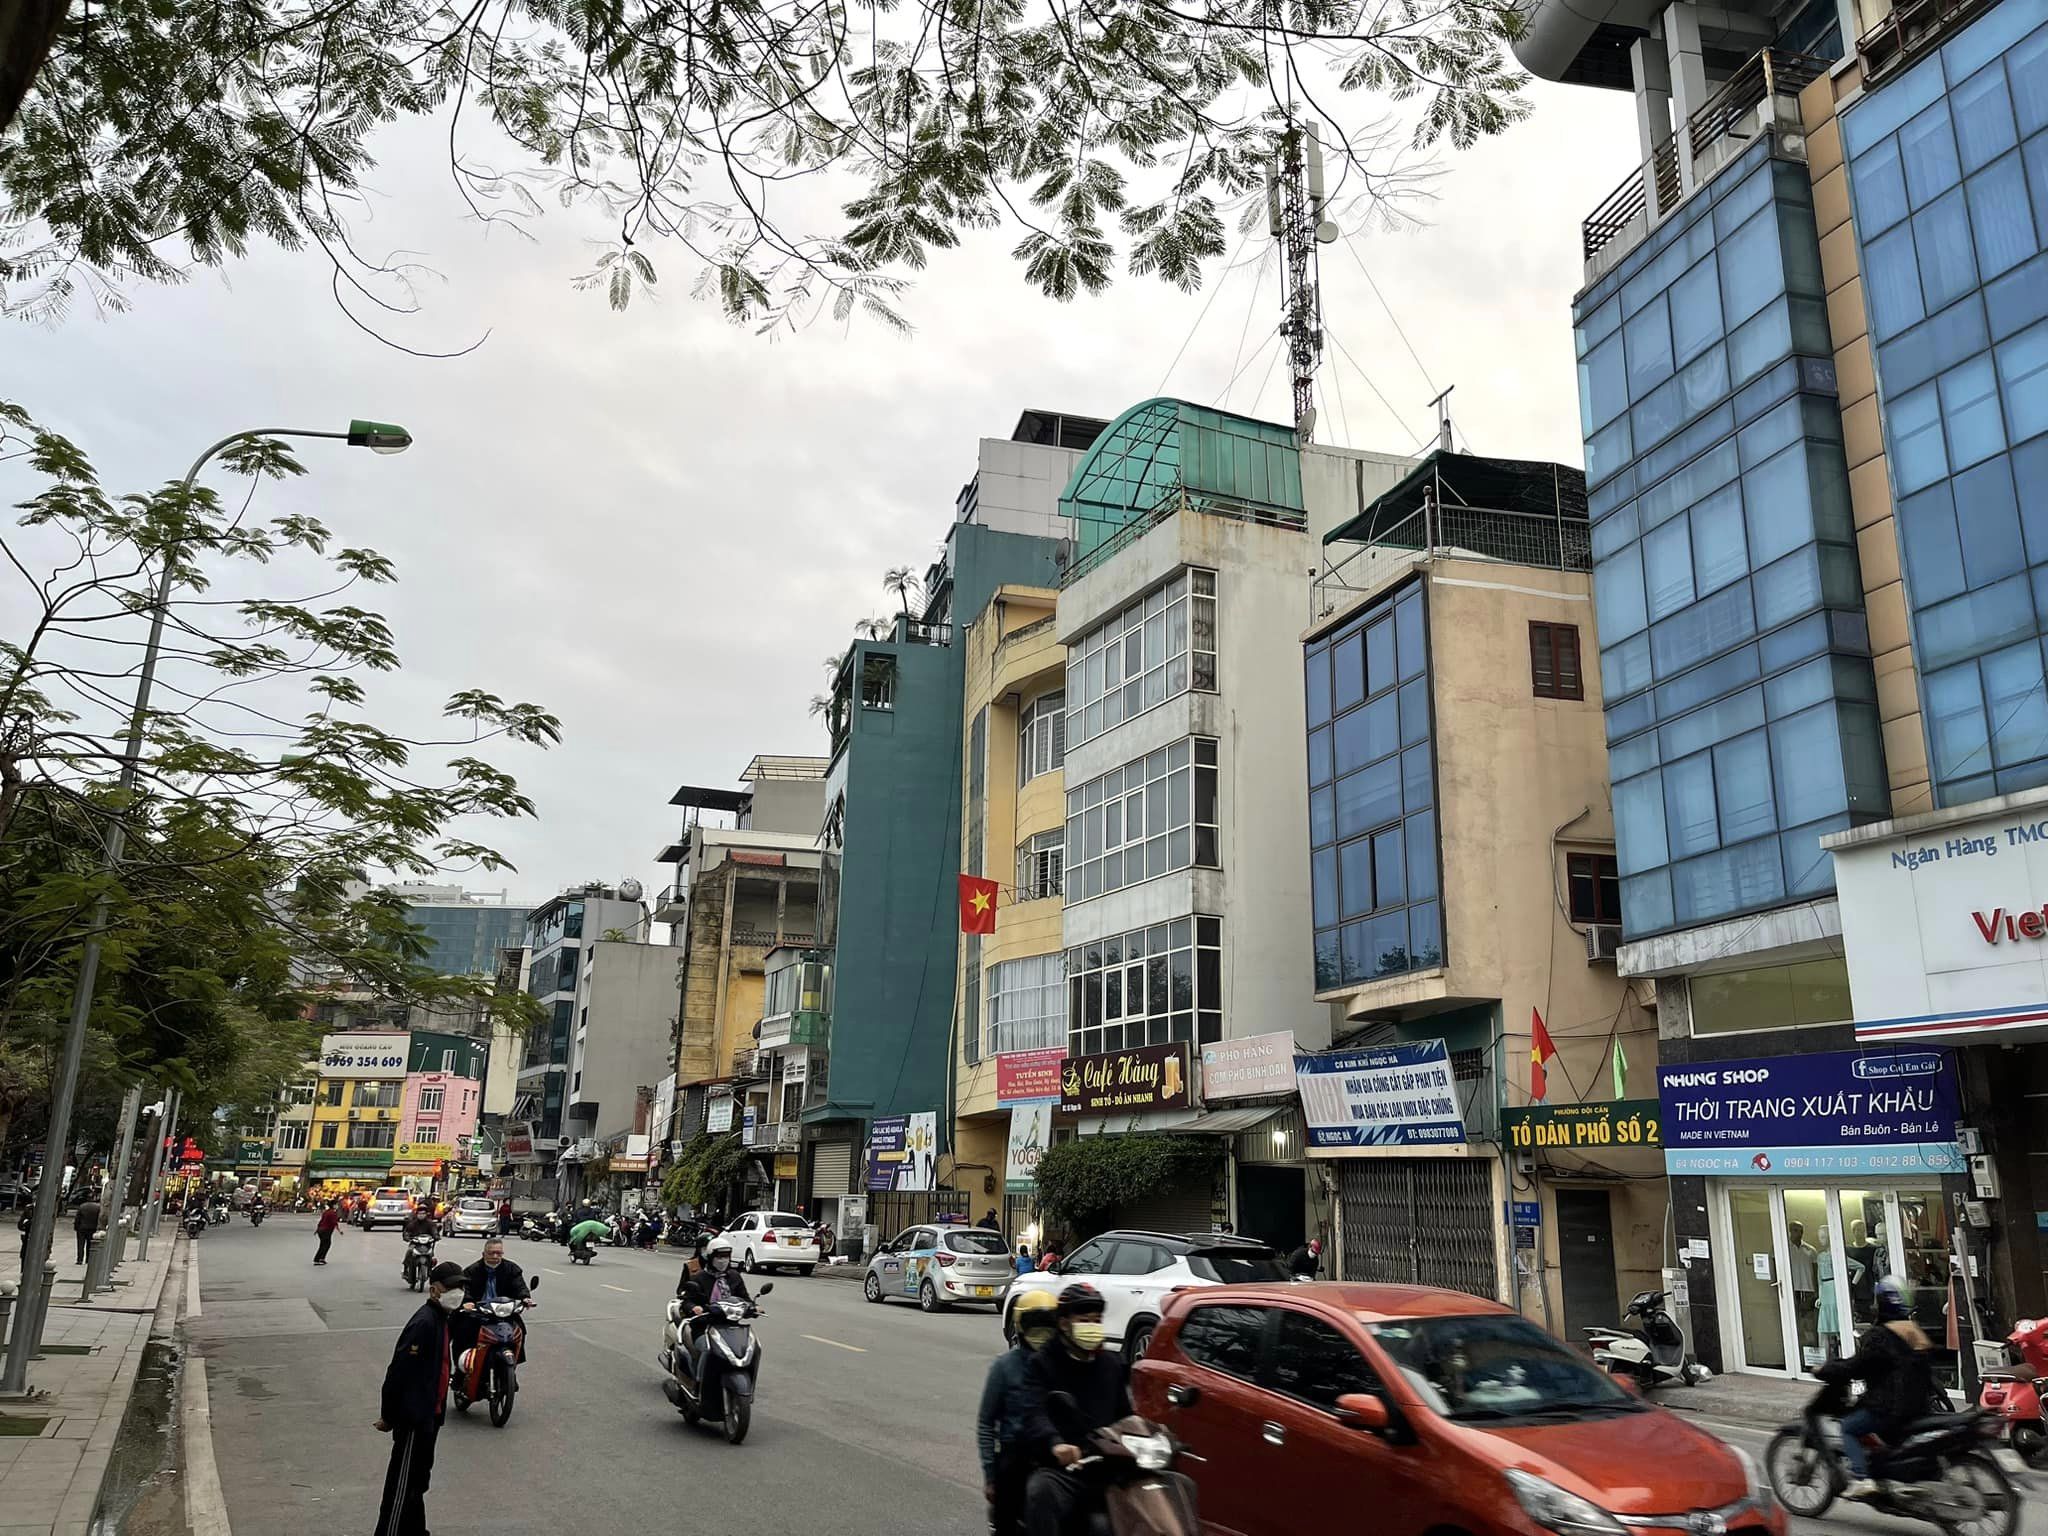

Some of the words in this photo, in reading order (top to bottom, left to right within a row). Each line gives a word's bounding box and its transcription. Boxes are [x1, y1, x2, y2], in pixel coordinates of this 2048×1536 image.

[1891, 847, 1940, 870] Ngân
[1945, 836, 1997, 856] Hàng
[325, 1056, 353, 1067] 0969
[356, 1056, 378, 1067] 354
[381, 1056, 403, 1067] 609
[1868, 1065, 1888, 1075] Shop
[1905, 1063, 1919, 1071] Em
[1920, 1061, 1936, 1070] Gái
[1084, 1058, 1113, 1093] Café
[1118, 1054, 1159, 1088] Hằng
[1663, 1071, 1717, 1088] NHUNG
[1722, 1068, 1769, 1084] SHOP
[1345, 1075, 1363, 1096] NHẬN
[1362, 1079, 1373, 1093] GIA
[1373, 1074, 1389, 1093] CÔNG
[1415, 1072, 1431, 1089] PHAY
[1091, 1096, 1104, 1107] SINH
[1104, 1092, 1111, 1106] TỐ
[1133, 1092, 1153, 1103] NHANH
[1301, 1077, 1348, 1123] INOX
[1675, 1097, 1719, 1121] THỜI
[1725, 1097, 1795, 1119] TRANG
[1801, 1090, 1862, 1116] XUẤT
[1351, 1103, 1365, 1120] MUA
[1365, 1100, 1377, 1119] BÁN
[1377, 1100, 1390, 1118] CÁC
[1389, 1102, 1403, 1120] LOẠI
[1403, 1100, 1419, 1117] INOX
[1419, 1097, 1432, 1119] ĐẶC
[1554, 1107, 1579, 1116] PHƯỜNG
[1581, 1107, 1593, 1115] ĐỘI
[1325, 1131, 1342, 1142] NGỌC
[1511, 1115, 1531, 1146] TỔ
[1535, 1119, 1570, 1145] DÂN
[1575, 1113, 1611, 1144] PHỐ
[1617, 1111, 1641, 1143] SỐ
[1646, 1119, 1659, 1142] 2
[1680, 1130, 1702, 1140] MADE
[1704, 1130, 1712, 1139] IN
[1714, 1130, 1749, 1139] VIETNAM
[1840, 1124, 1861, 1136] Bán
[1863, 1123, 1891, 1135] Buôn
[1901, 1121, 1922, 1134] Bán
[1925, 1120, 1939, 1133] Lẻ
[1012, 1148, 1041, 1165] YOGA
[1784, 1157, 1810, 1168] 0904
[1814, 1157, 1833, 1168] 117
[1839, 1157, 1858, 1167] 103
[1869, 1156, 1898, 1167] 0912
